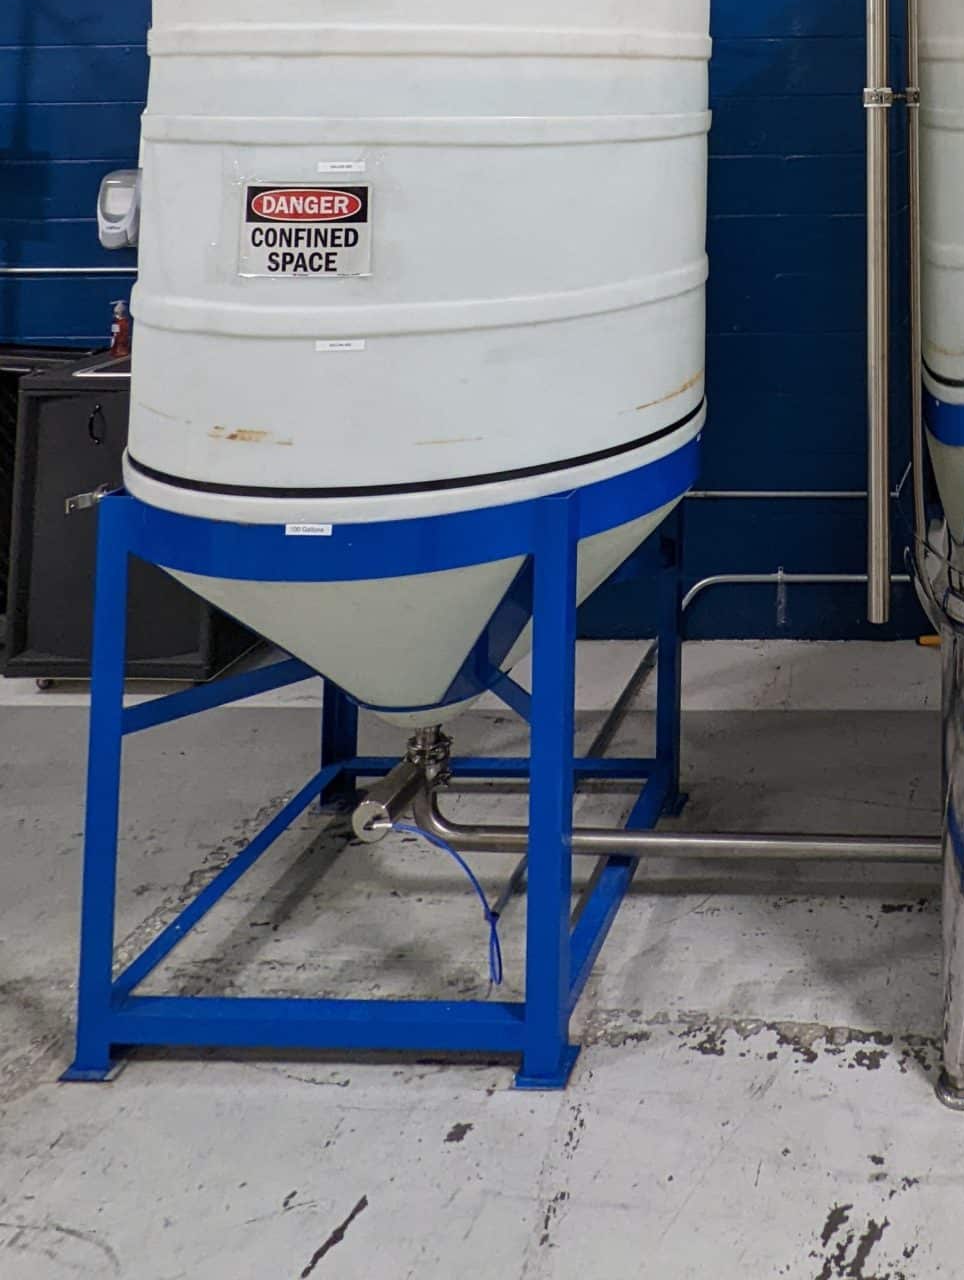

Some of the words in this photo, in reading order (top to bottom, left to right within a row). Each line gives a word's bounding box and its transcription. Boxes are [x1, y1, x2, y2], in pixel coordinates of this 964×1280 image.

[262, 196, 349, 214] DANGER
[251, 227, 359, 248] CONFINED
[267, 252, 337, 272] SPACE
